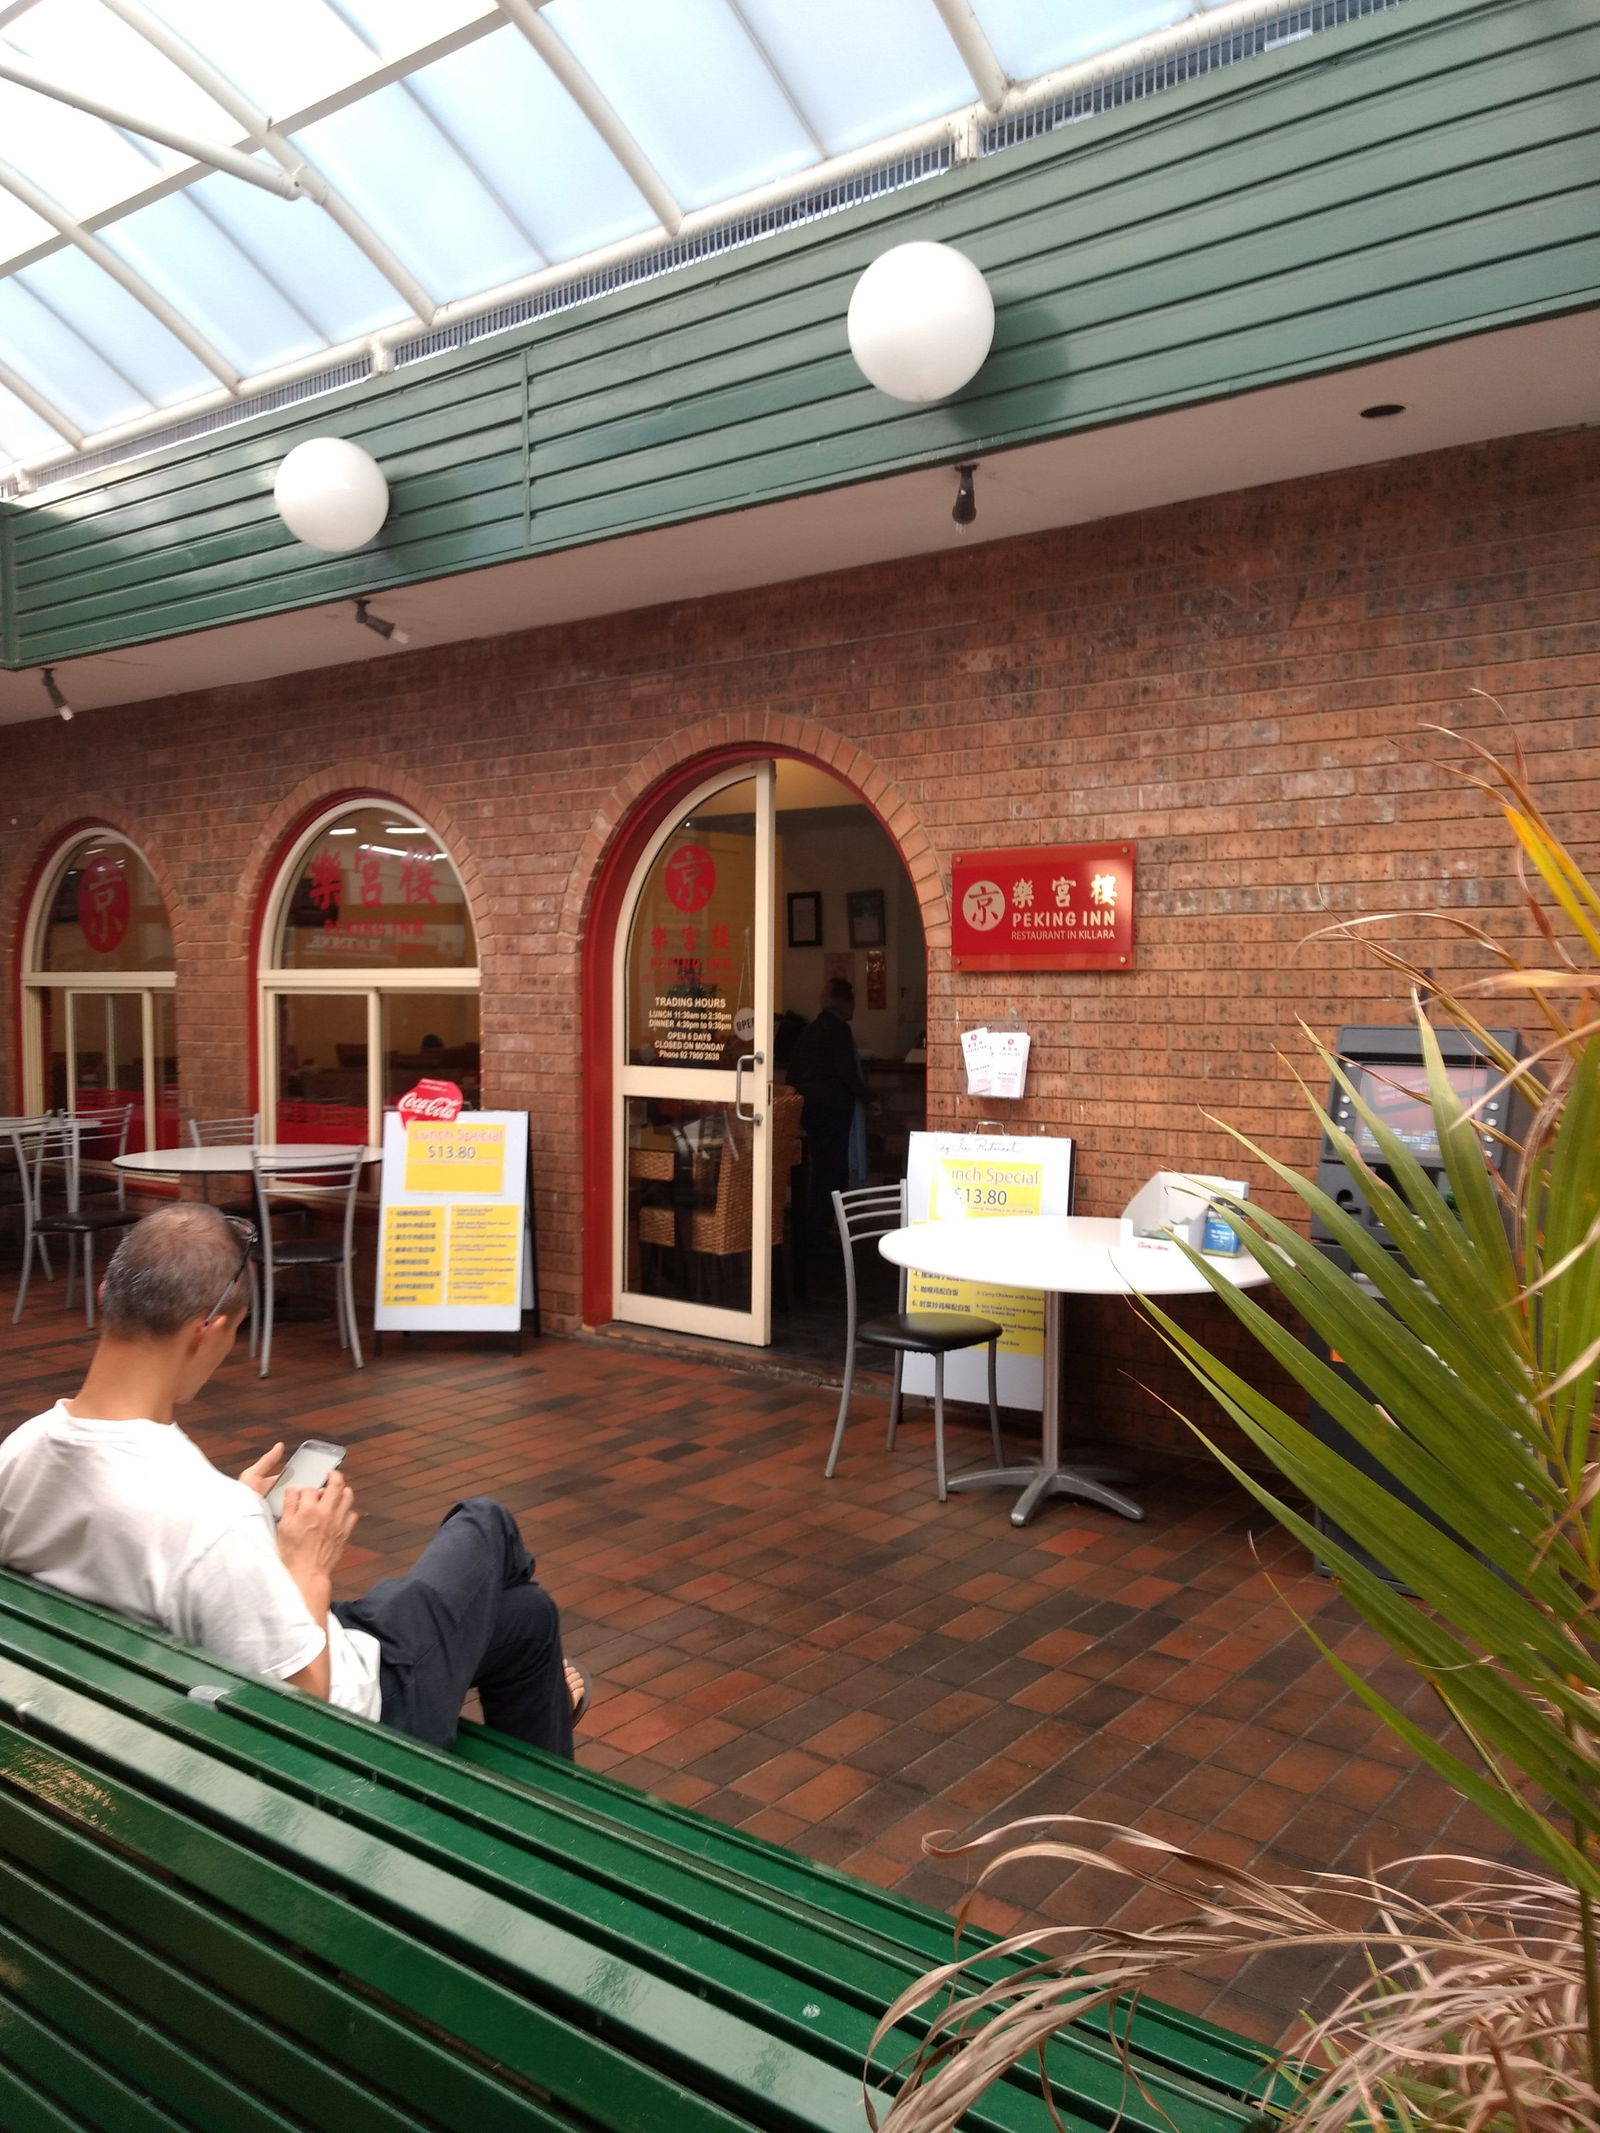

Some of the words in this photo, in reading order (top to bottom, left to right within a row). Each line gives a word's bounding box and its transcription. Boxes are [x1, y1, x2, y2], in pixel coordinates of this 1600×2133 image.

[671, 850, 709, 906] 京
[968, 886, 1000, 926] 京
[1012, 911, 1076, 928] PEKING
[1083, 910, 1116, 926] INN
[1011, 930, 1065, 940] RESTAURANT
[1067, 930, 1077, 940] IN
[1078, 930, 1115, 939] KILLARA
[655, 997, 693, 1007] TRADING
[694, 998, 727, 1008] HOURS
[648, 1010, 672, 1018] LUNCH
[648, 1019, 674, 1028] DINNER
[667, 1032, 687, 1040] OPEN
[692, 1033, 712, 1041] DAYS
[654, 1040, 682, 1049] CLOSED
[683, 1042, 694, 1050] ON
[695, 1042, 725, 1052] MONDAY
[658, 1050, 679, 1058] Phone
[413, 1128, 453, 1142] Lunch
[457, 1128, 503, 1144] Special
[426, 1145, 477, 1160] $13.80
[986, 1167, 1039, 1186] Special
